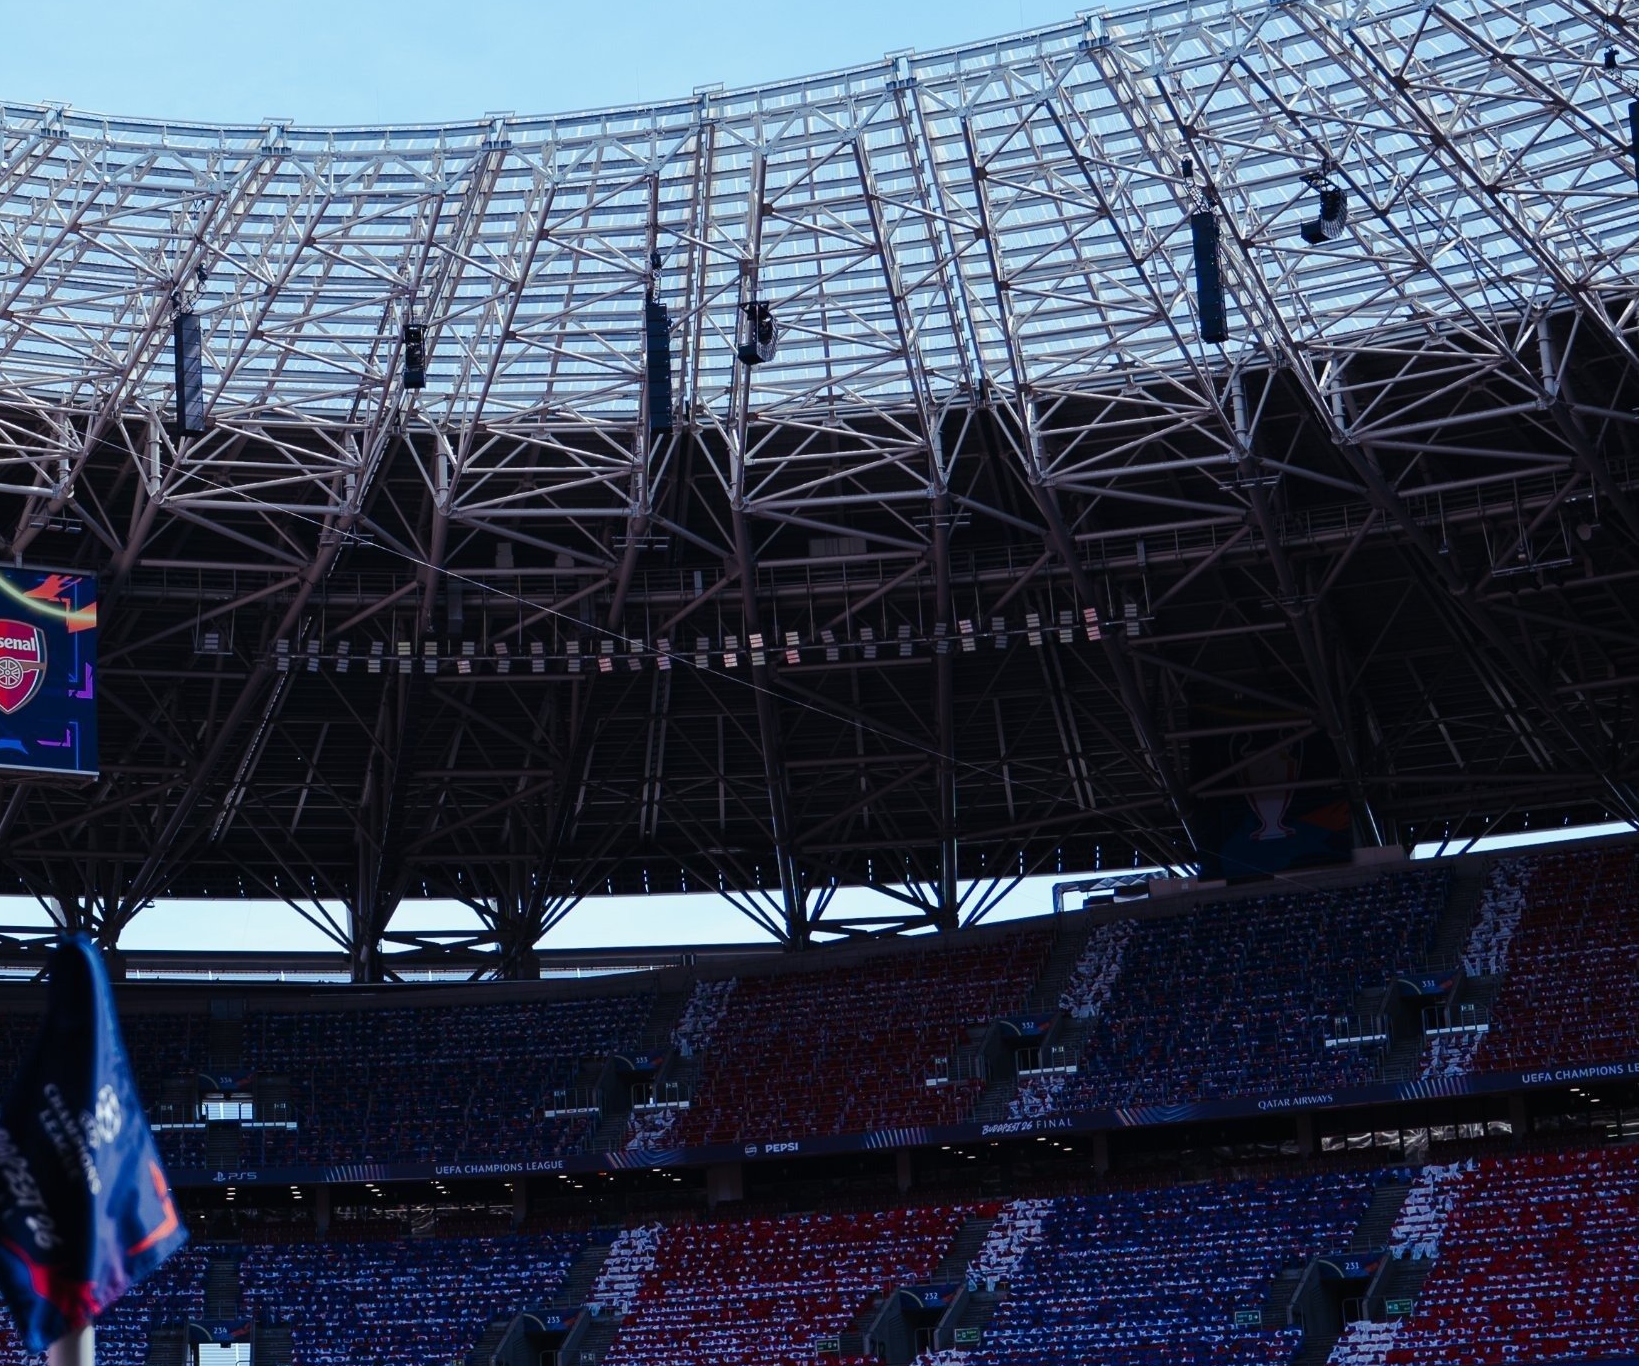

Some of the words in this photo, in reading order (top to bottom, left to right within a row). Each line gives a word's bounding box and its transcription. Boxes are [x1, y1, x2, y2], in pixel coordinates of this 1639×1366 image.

[1522, 1072, 1552, 1084] UEFA
[1555, 1064, 1624, 1081] CHAMPIONS
[1258, 1098, 1290, 1110] QATAR
[1292, 1094, 1333, 1106] AIRWAYS
[1036, 1118, 1073, 1130] FINAL
[765, 1142, 799, 1154] PEPSI
[435, 1165, 462, 1175] UEFA
[464, 1162, 523, 1174] CHAMPIONS
[526, 1160, 564, 1171] LEAGUE
[228, 1171, 257, 1180] PS5
[1345, 1262, 1360, 1270] 231
[924, 1292, 938, 1301] 232
[547, 1316, 561, 1324] 233
[213, 1326, 228, 1334] 234
